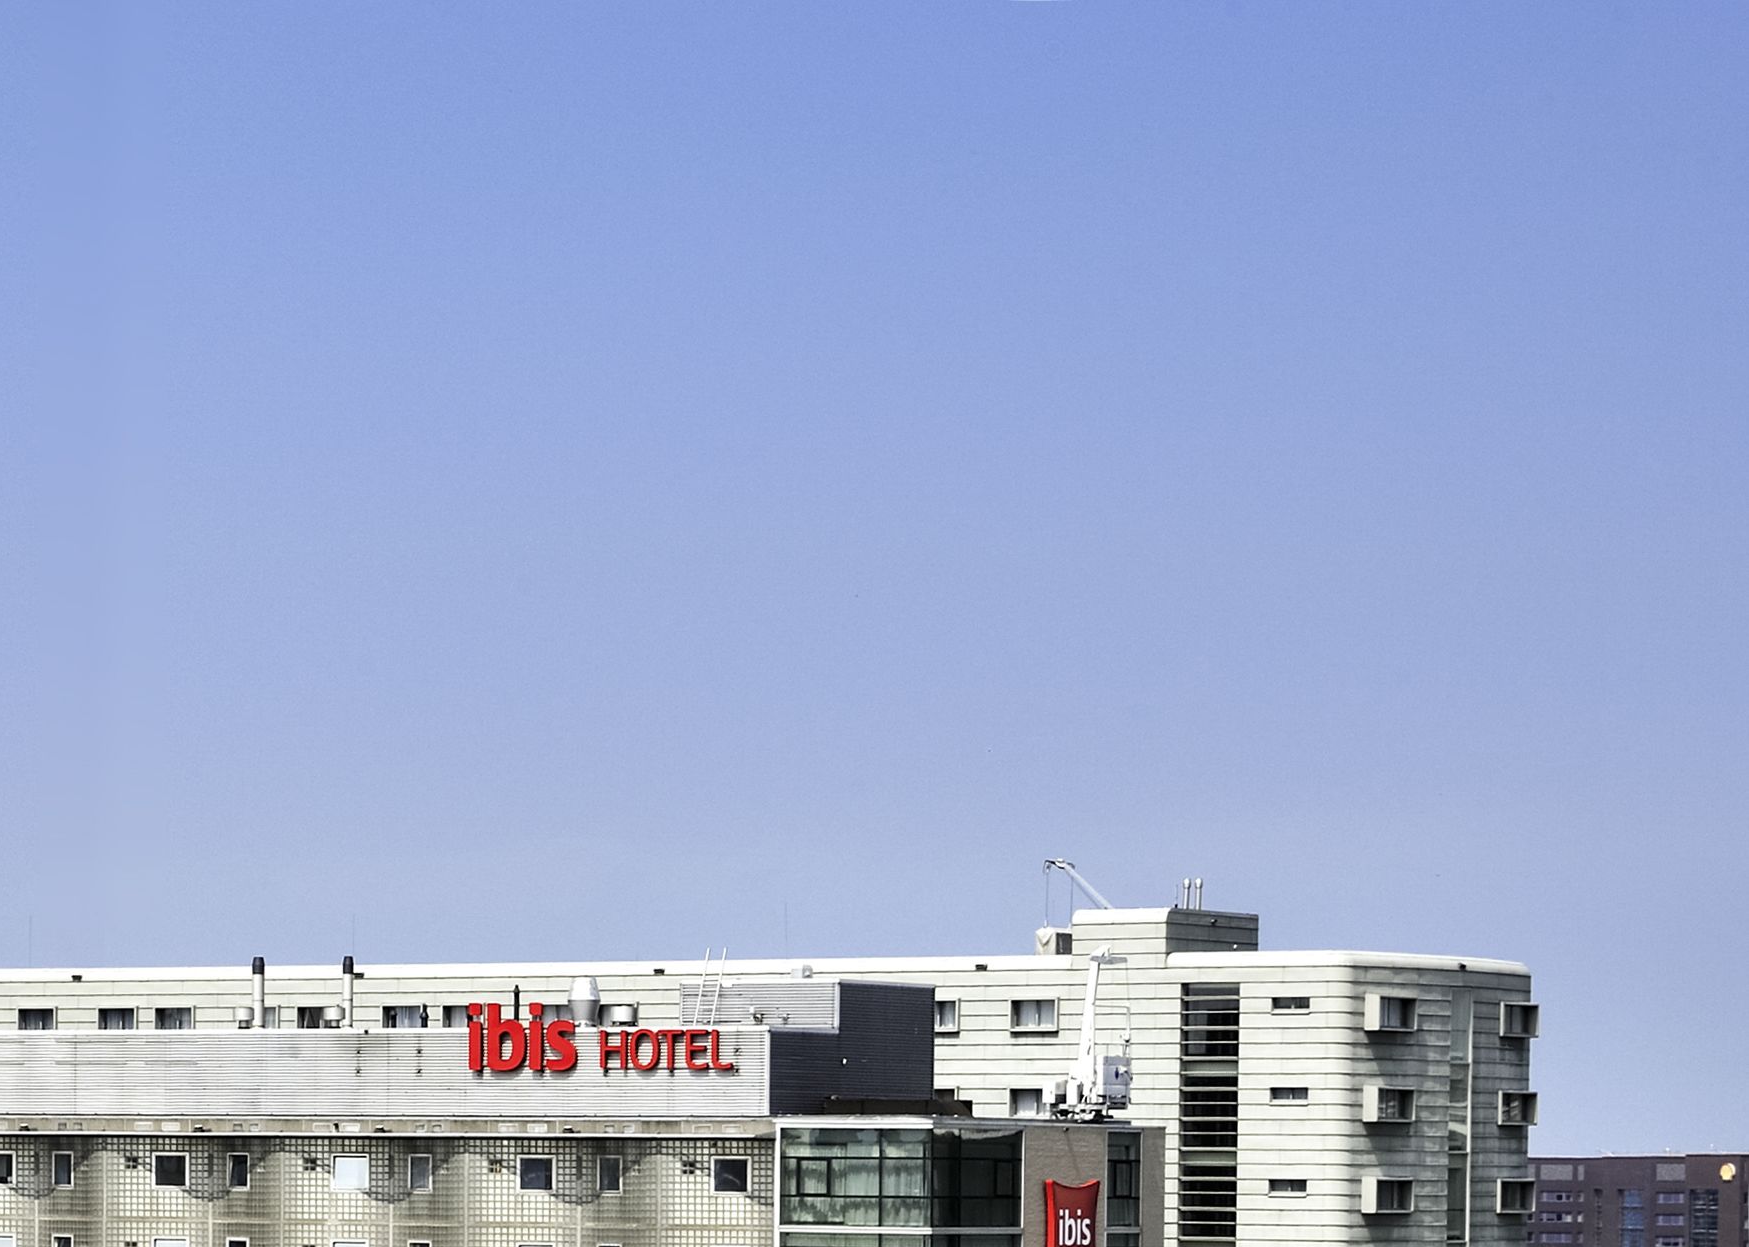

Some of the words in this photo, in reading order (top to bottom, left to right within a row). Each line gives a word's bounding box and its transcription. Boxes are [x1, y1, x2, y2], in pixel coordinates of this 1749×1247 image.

[468, 1003, 578, 1071] ibis
[600, 1029, 733, 1070] HOTEL
[1059, 1209, 1091, 1246] ibis
